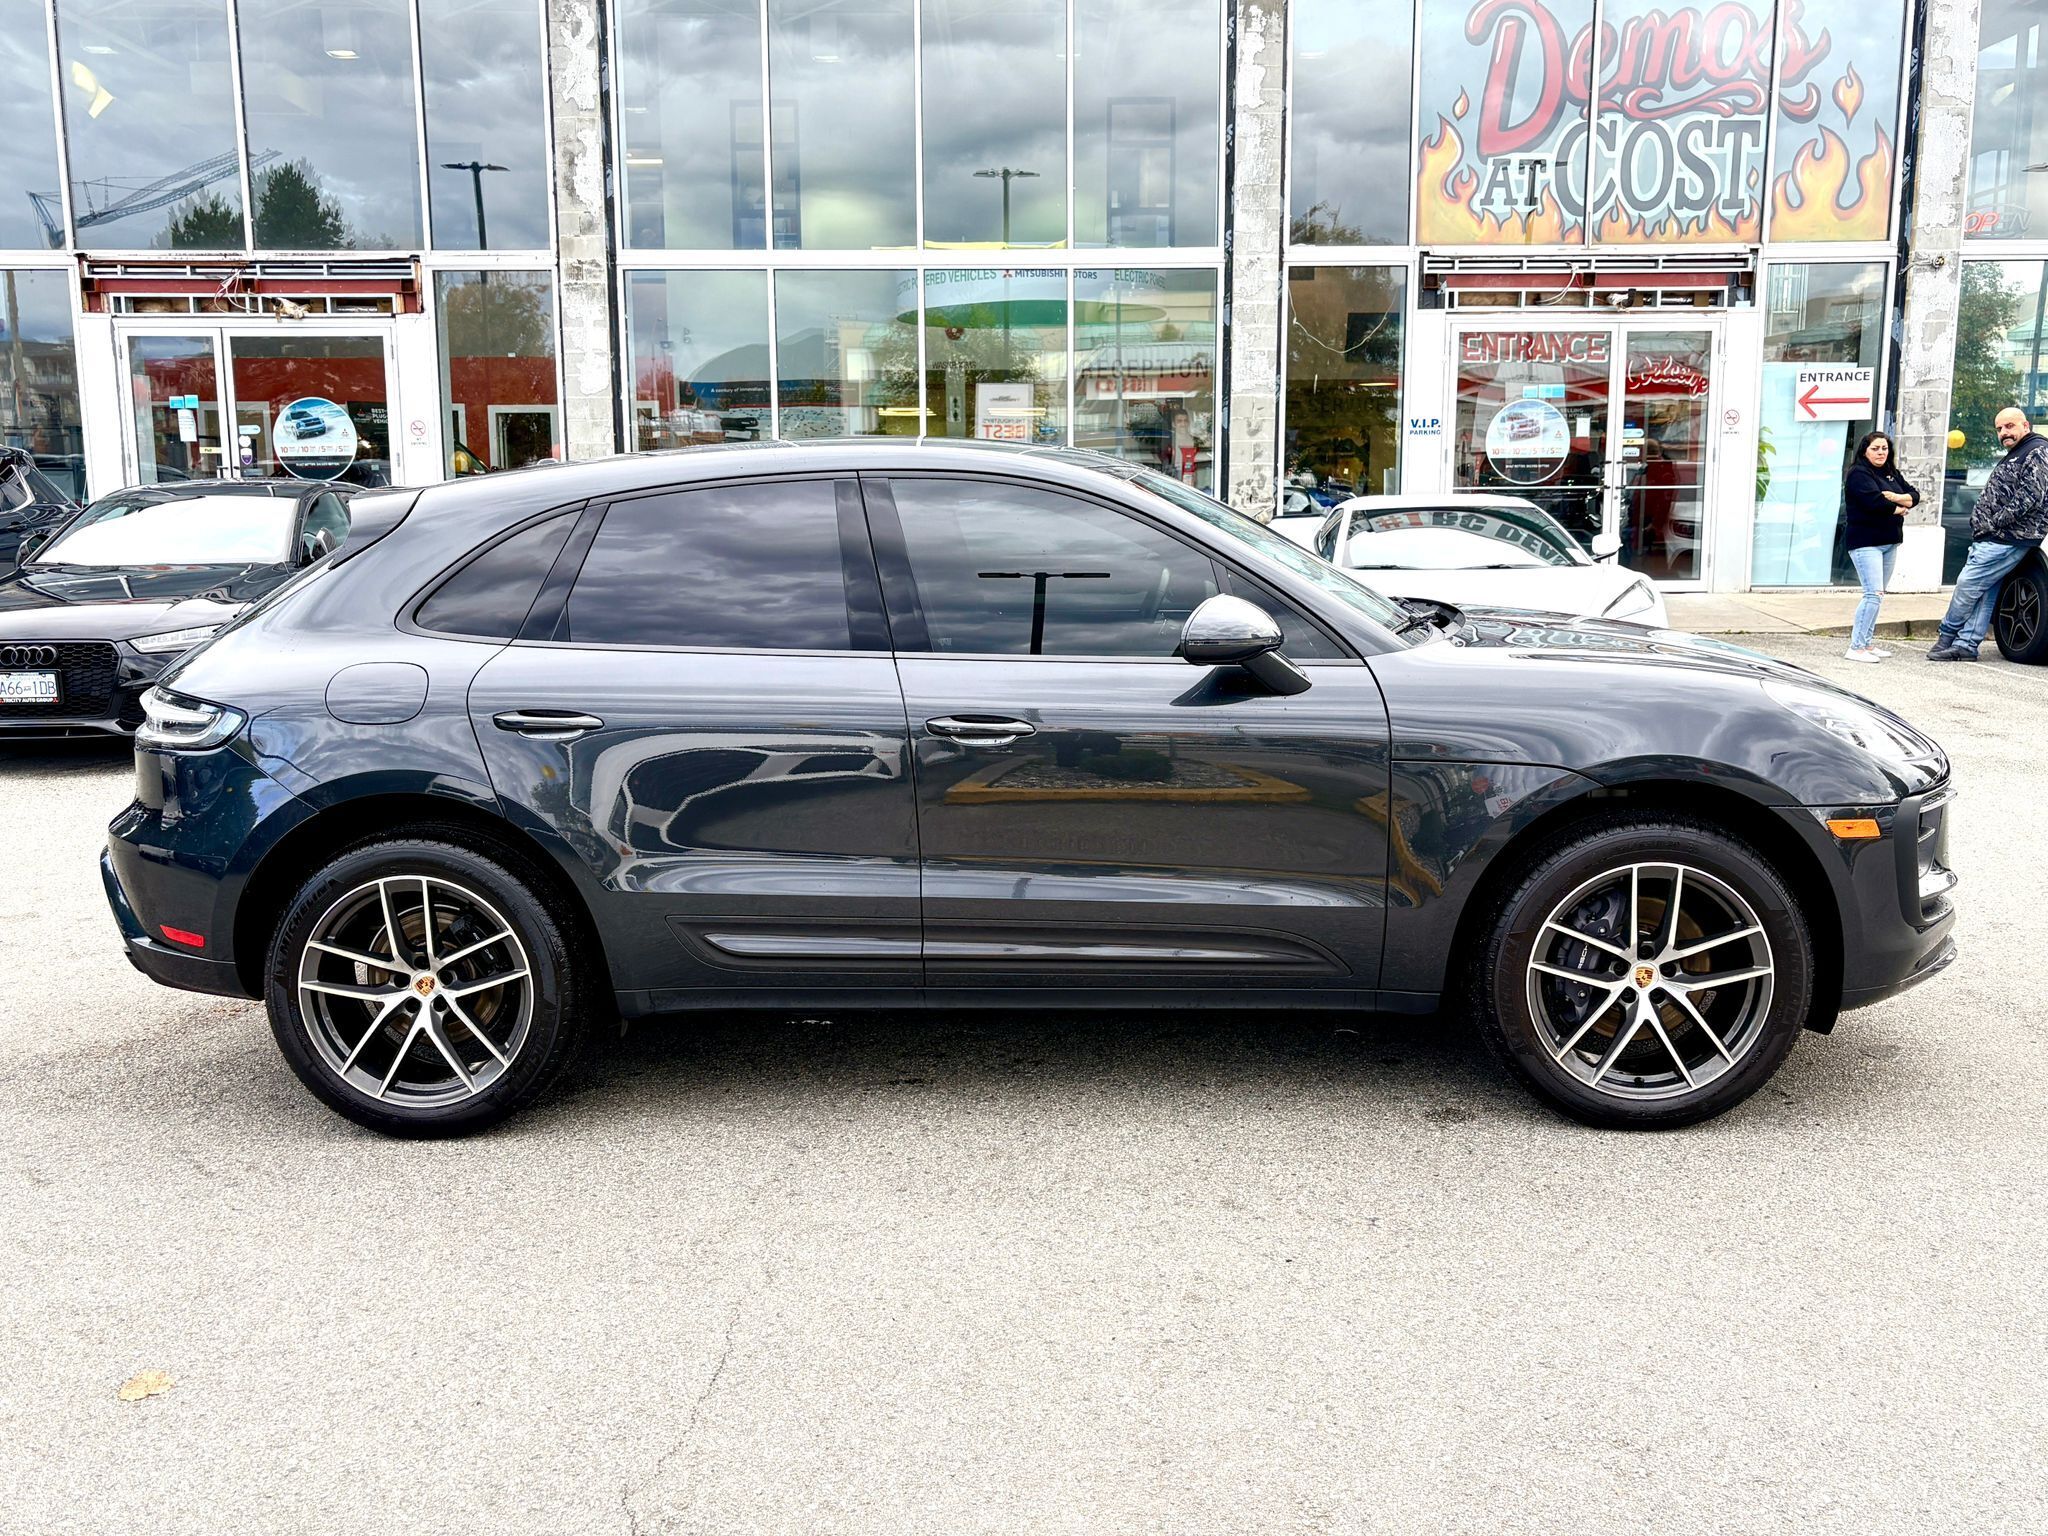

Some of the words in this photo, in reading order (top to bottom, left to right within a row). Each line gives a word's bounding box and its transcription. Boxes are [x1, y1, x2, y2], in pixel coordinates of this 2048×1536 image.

[1465, 0, 1832, 164] Demos
[1480, 158, 1547, 207] AT
[1555, 119, 1762, 217] COST
[1963, 210, 2032, 232] OPEN
[950, 269, 997, 282] VEHICLES
[1014, 269, 1063, 278] MITSUBISHI
[1460, 332, 1608, 363] ENTRANCE
[1799, 371, 1871, 383] ENTRANCE
[1410, 418, 1441, 428] V.I.P.
[280, 446, 289, 454] 10
[301, 445, 309, 453] 10
[1491, 447, 1500, 455] 10
[1431, 511, 1488, 532] BC
